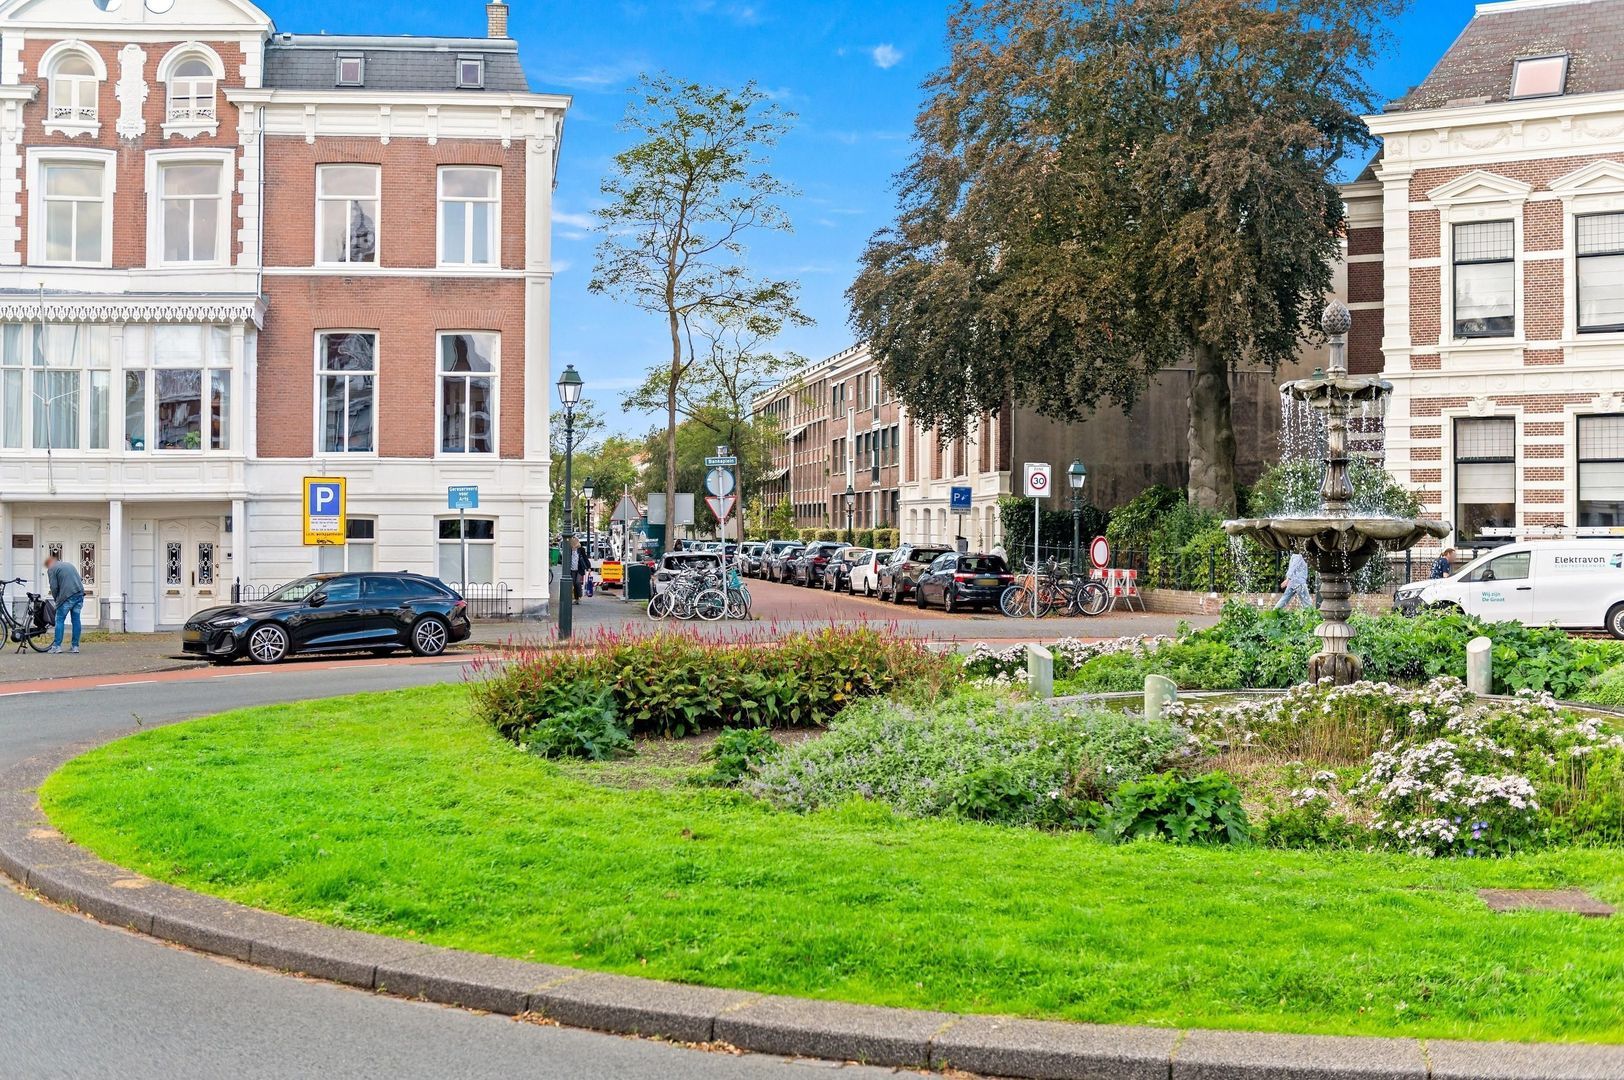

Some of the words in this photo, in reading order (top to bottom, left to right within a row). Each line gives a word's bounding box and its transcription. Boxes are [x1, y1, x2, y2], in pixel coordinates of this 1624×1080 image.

[1033, 477, 1045, 485] 30
[316, 486, 334, 512] P
[953, 492, 961, 502] P
[1554, 556, 1606, 564] Elektravon
